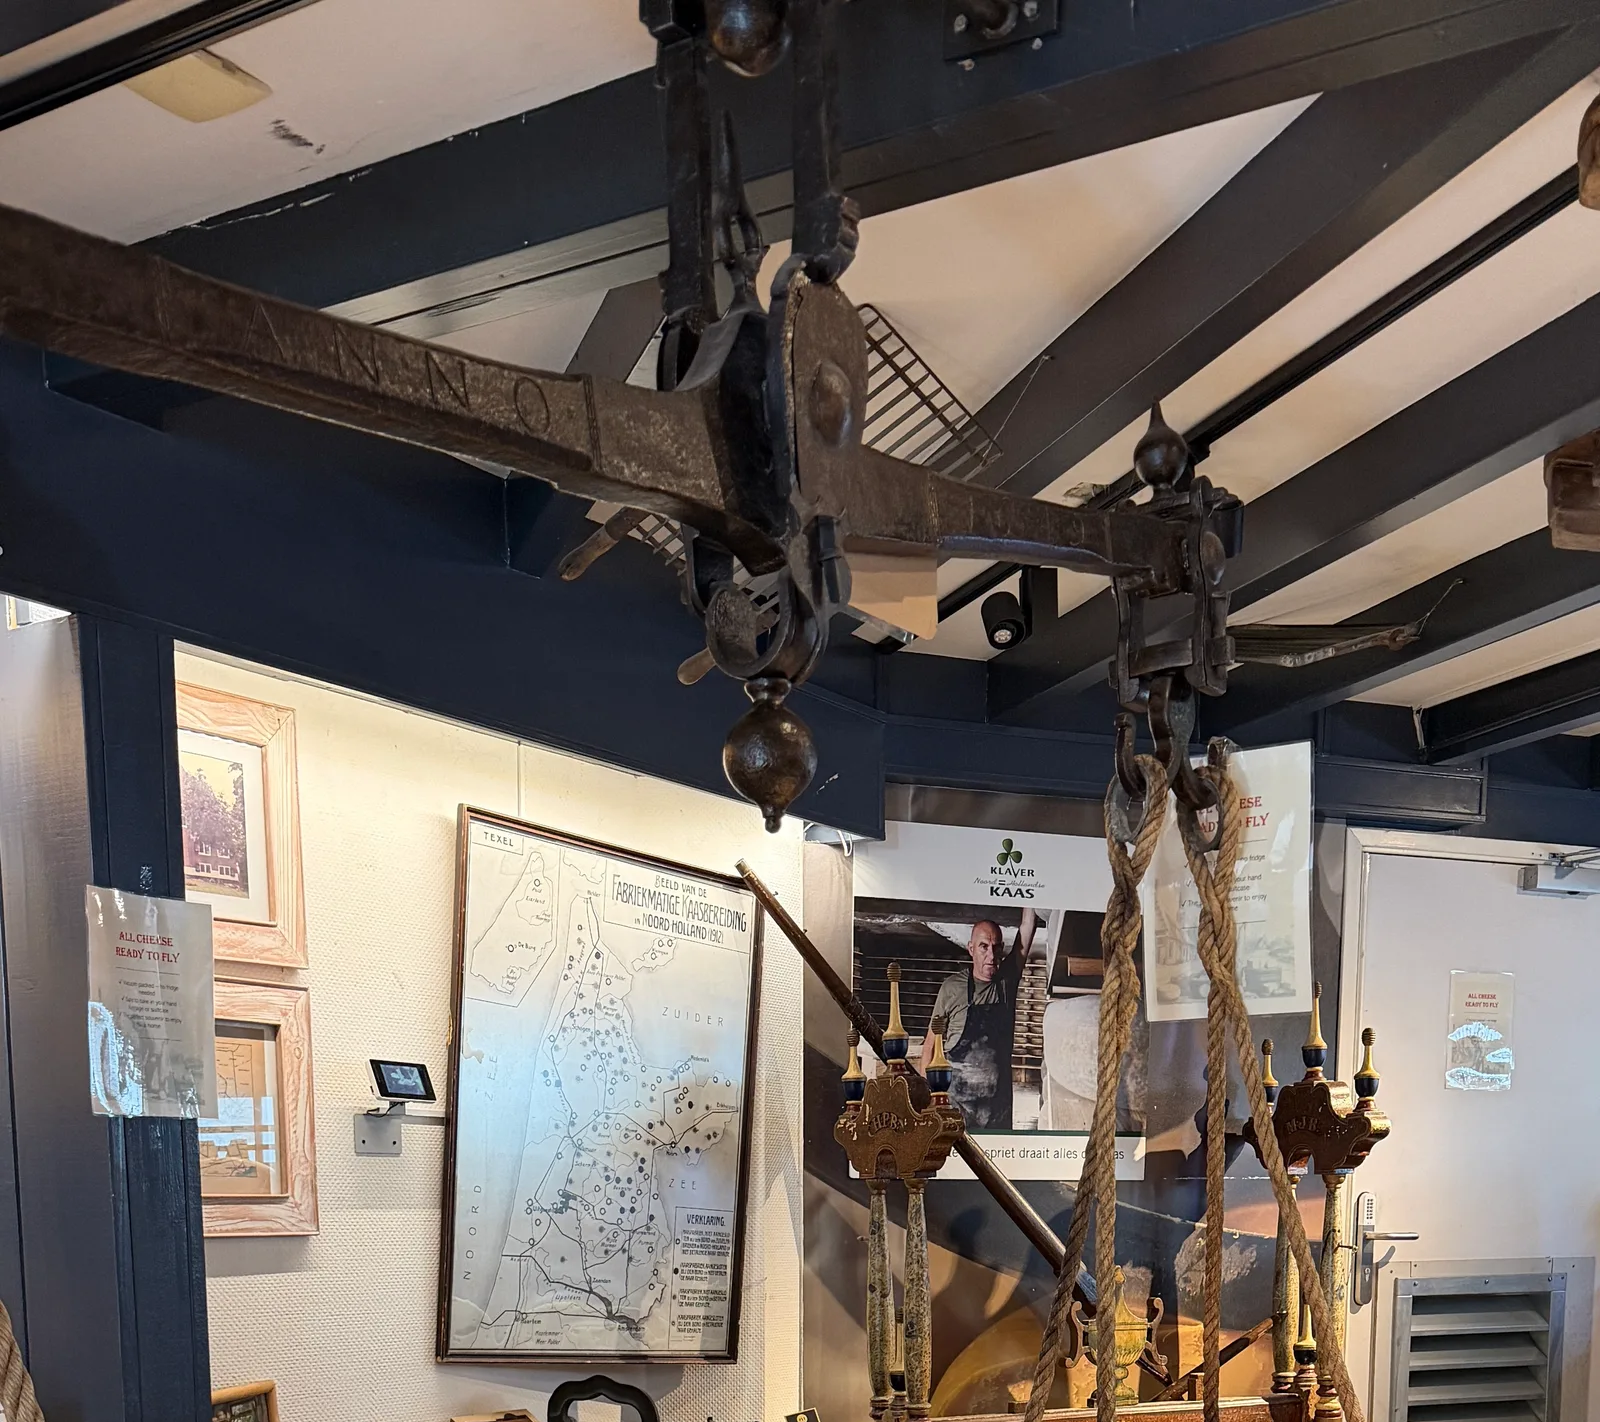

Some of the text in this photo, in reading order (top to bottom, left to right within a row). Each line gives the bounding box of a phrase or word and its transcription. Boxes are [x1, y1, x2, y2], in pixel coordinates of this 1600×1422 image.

[243, 303, 551, 436] ANNO
[1246, 812, 1270, 828] FLY
[484, 832, 514, 846] TEXEL
[990, 867, 1034, 878] KLAVER
[655, 875, 706, 898] BEELD VAN DE
[990, 886, 1034, 898] KAAS
[612, 874, 746, 932] FABRIEKMATIGE KAASBEREIDING
[642, 913, 670, 931] NOORD
[672, 920, 706, 940] HOLLAND
[119, 932, 173, 946] ALL CHEESE
[116, 946, 180, 963] READY TO FLY
[662, 1007, 724, 1026] ZUIDER
[1019, 1147, 1050, 1159] draait
[1054, 1148, 1078, 1160] alles
[668, 1178, 696, 1190] ZEE
[462, 1184, 482, 1280] NOORD
